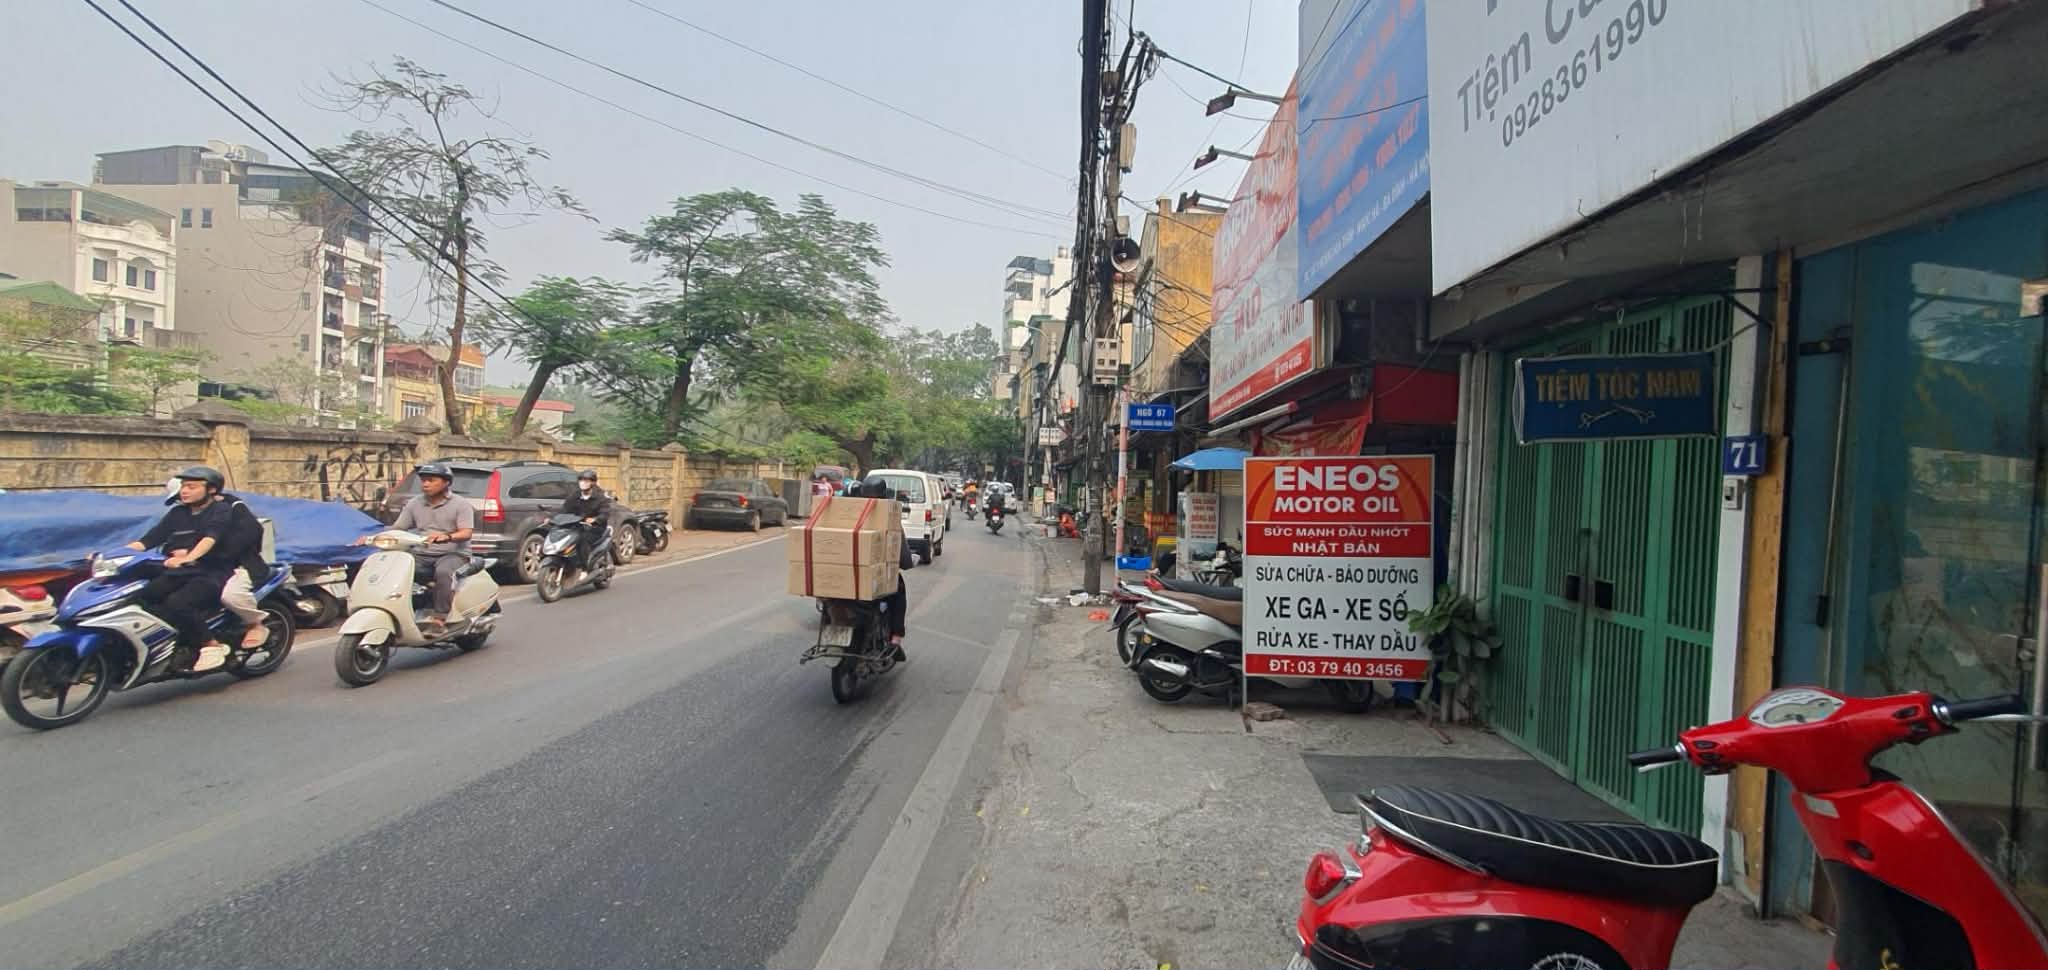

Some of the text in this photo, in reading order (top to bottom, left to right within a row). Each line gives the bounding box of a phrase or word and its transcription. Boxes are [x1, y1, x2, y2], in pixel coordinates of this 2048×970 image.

[1457, 31, 1531, 133] Tiệm
[1502, 0, 1668, 148] 0928361990
[1536, 366, 1702, 409] TIỆM TÓC NAM
[1730, 441, 1761, 469] 71
[1273, 464, 1400, 492] ENEOS
[1274, 496, 1400, 513] MOTOR OIL
[1263, 525, 1411, 539] SỨC MẠNH DẦU NHỚT
[1292, 540, 1380, 556] NHẬT BẢN
[1256, 562, 1284, 582] SỬA
[1287, 564, 1325, 583] CHỮA
[1335, 563, 1364, 584] BẢO
[1367, 564, 1419, 584] DƯỠNG
[1265, 595, 1291, 619] XE
[1297, 596, 1327, 620] GA
[1345, 598, 1372, 621] XE
[1379, 589, 1409, 622] SỐ
[1256, 626, 1293, 648] RỬA
[1297, 632, 1319, 649] XE
[1333, 633, 1376, 651] THAY
[1381, 628, 1417, 652] DẦU
[1268, 659, 1404, 677] ĐT: 03 79 40 3456
